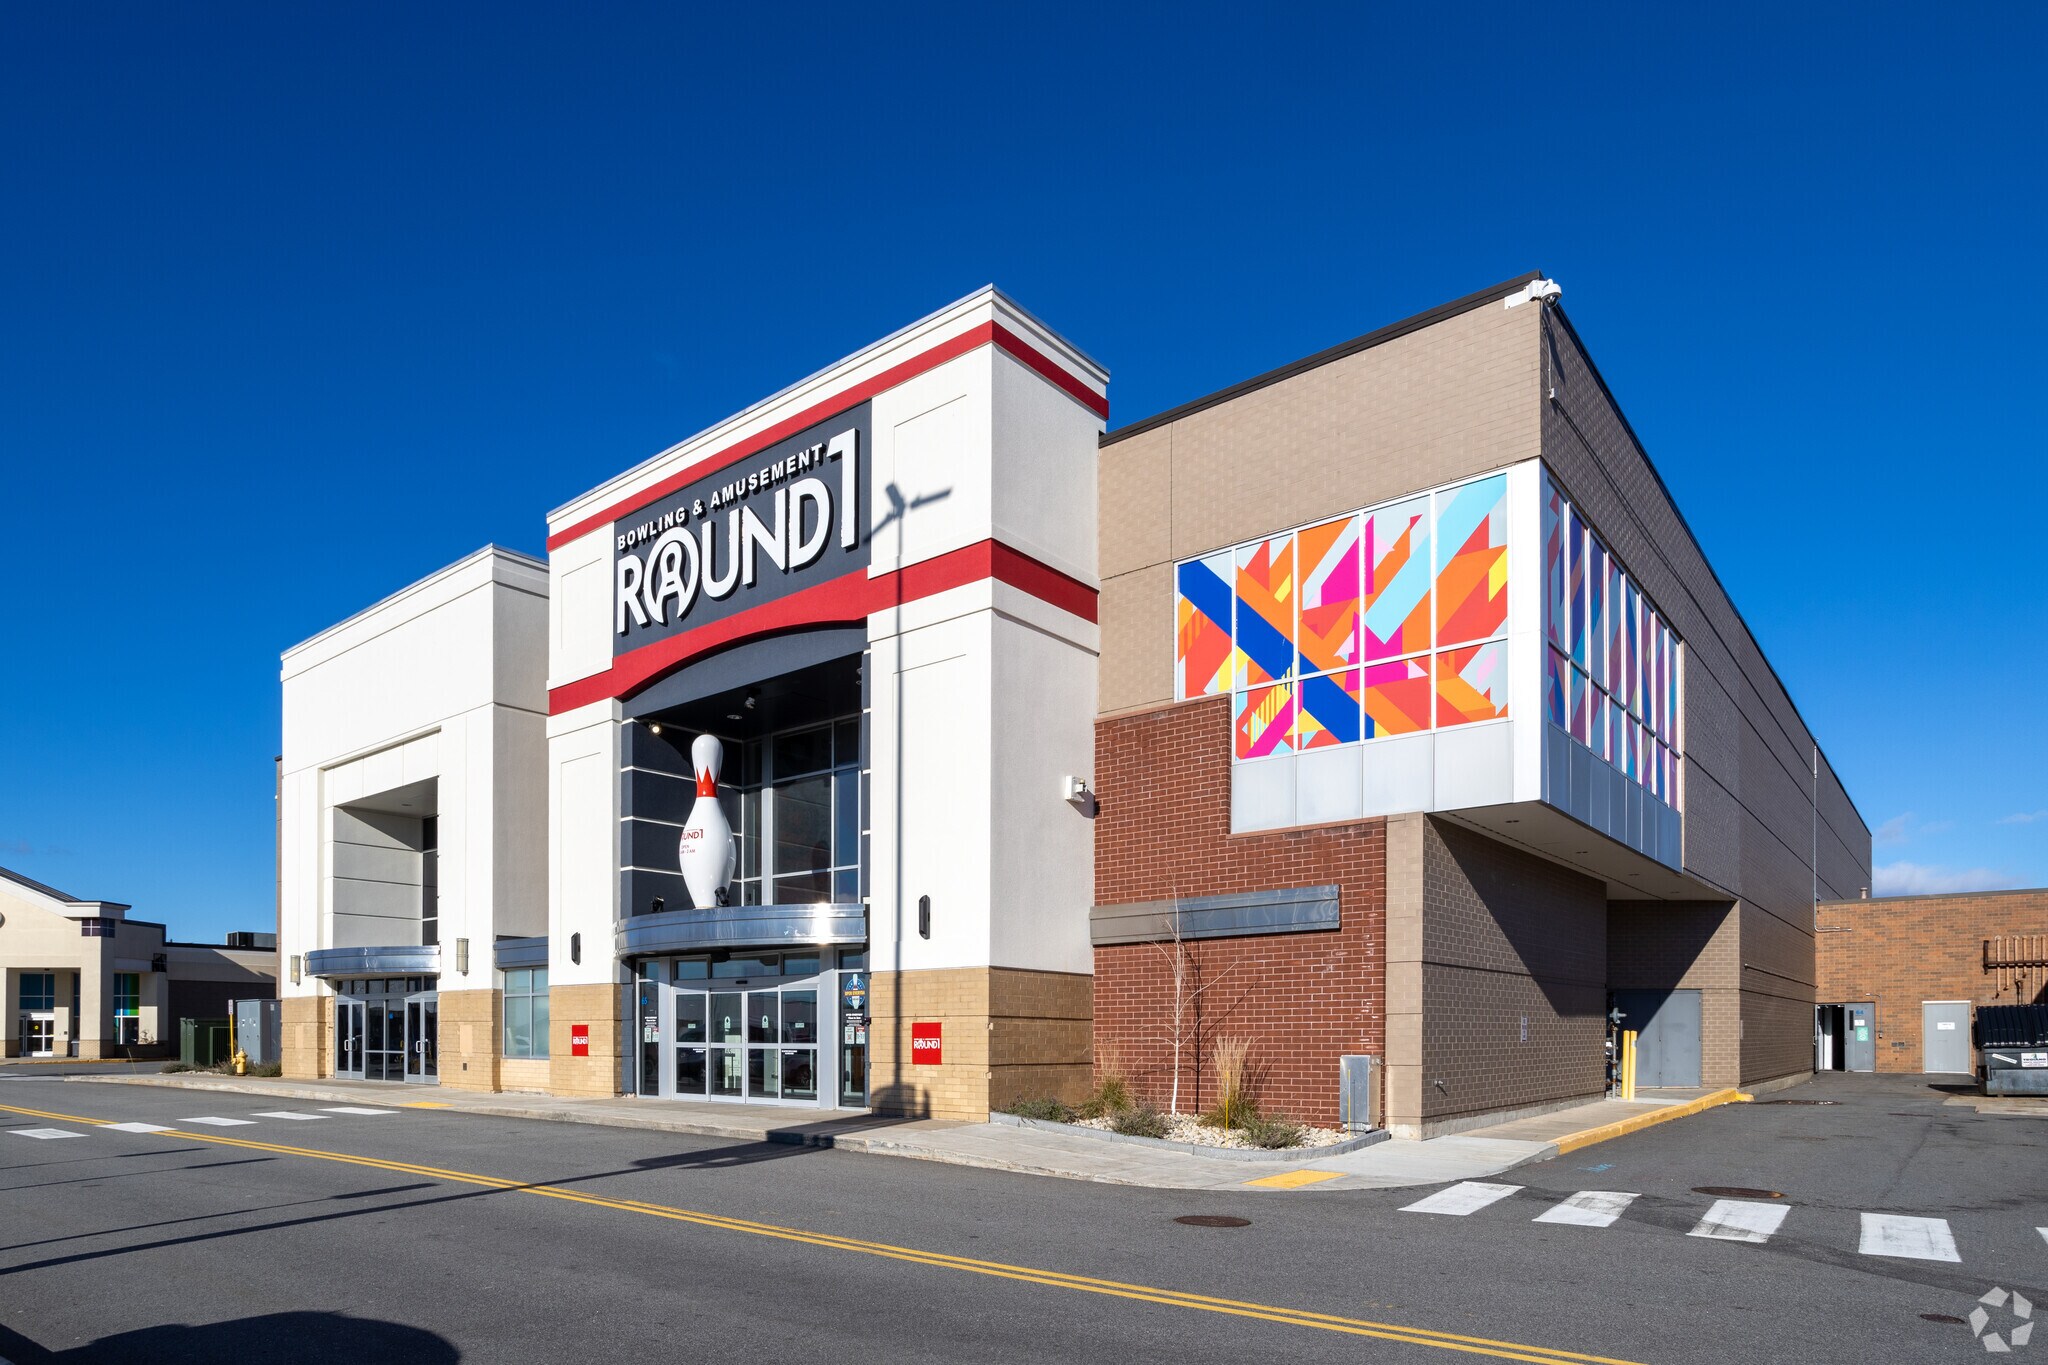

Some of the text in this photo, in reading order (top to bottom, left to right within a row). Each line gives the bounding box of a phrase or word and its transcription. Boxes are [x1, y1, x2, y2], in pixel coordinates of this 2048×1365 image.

[617, 442, 823, 551] BOWLING & AMUSEMENT
